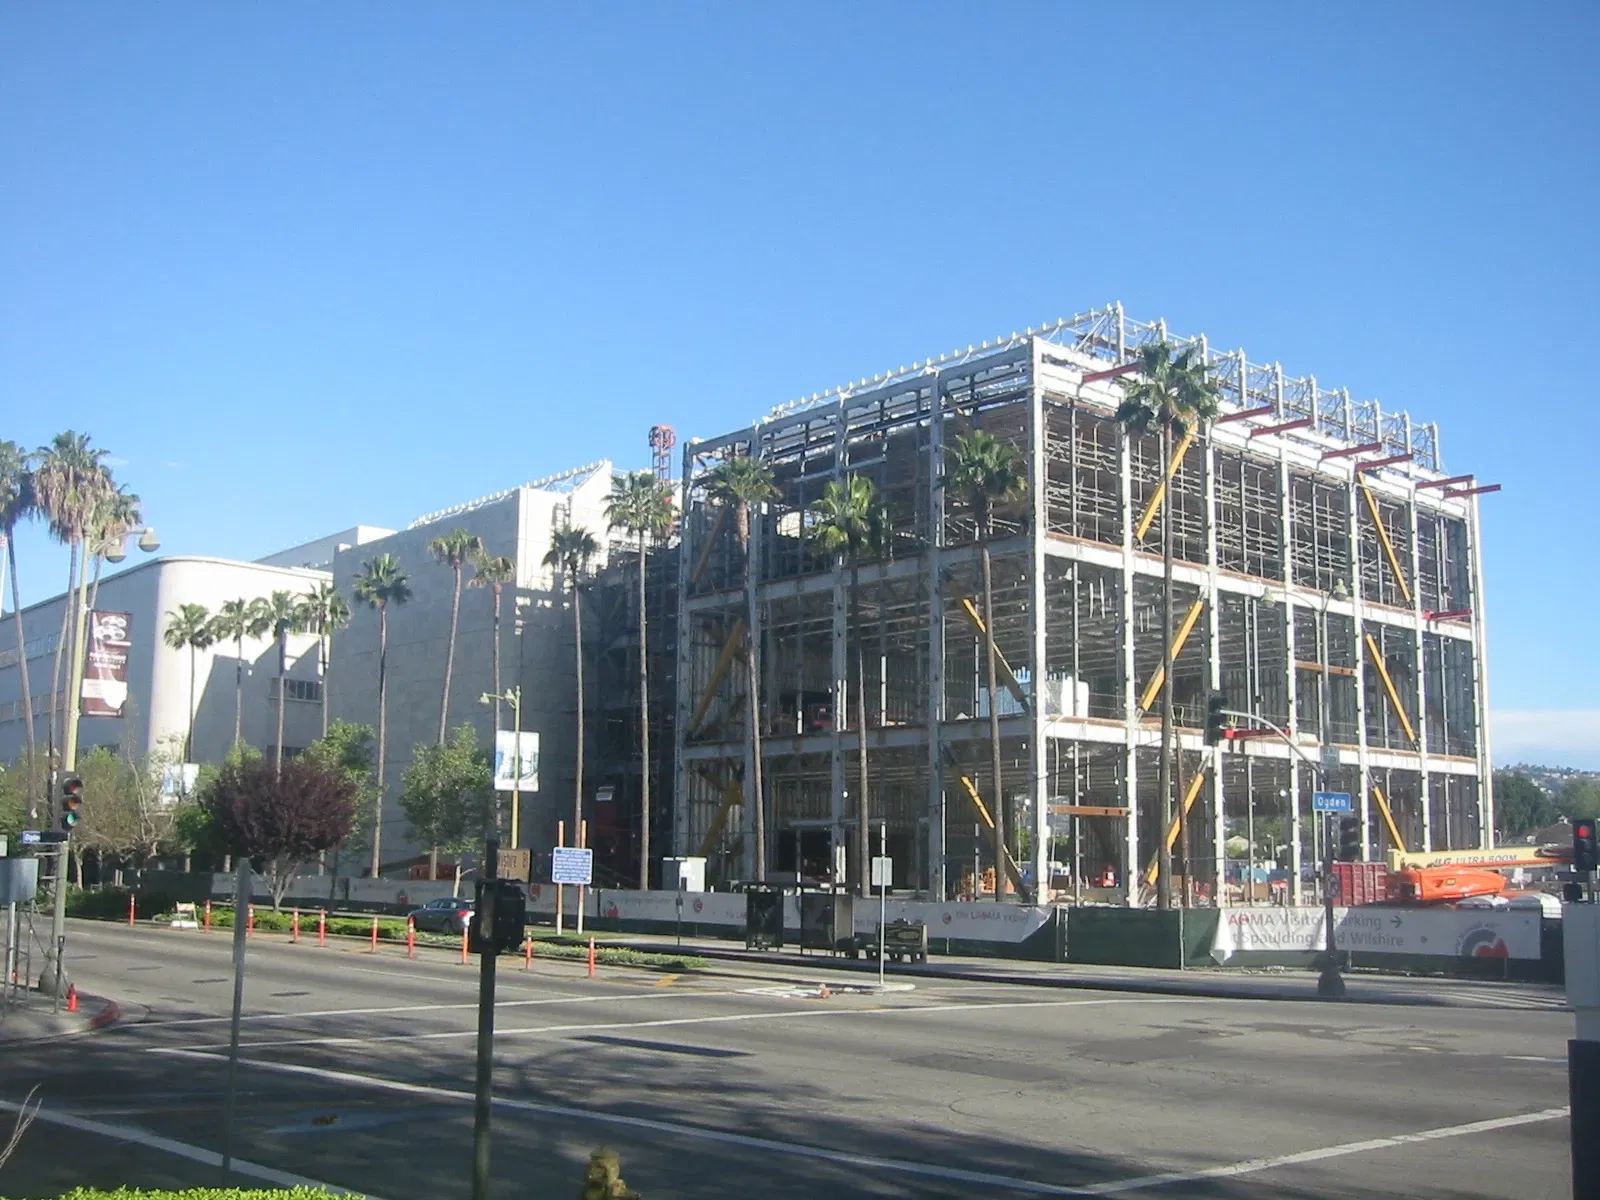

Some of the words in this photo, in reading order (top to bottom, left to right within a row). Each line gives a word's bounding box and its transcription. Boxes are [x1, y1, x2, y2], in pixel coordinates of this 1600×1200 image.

[1317, 796, 1346, 809] Ogden
[1333, 914, 1382, 931] Parking
[1242, 931, 1314, 948] Spaulding
[1349, 932, 1404, 947] Wilshire
